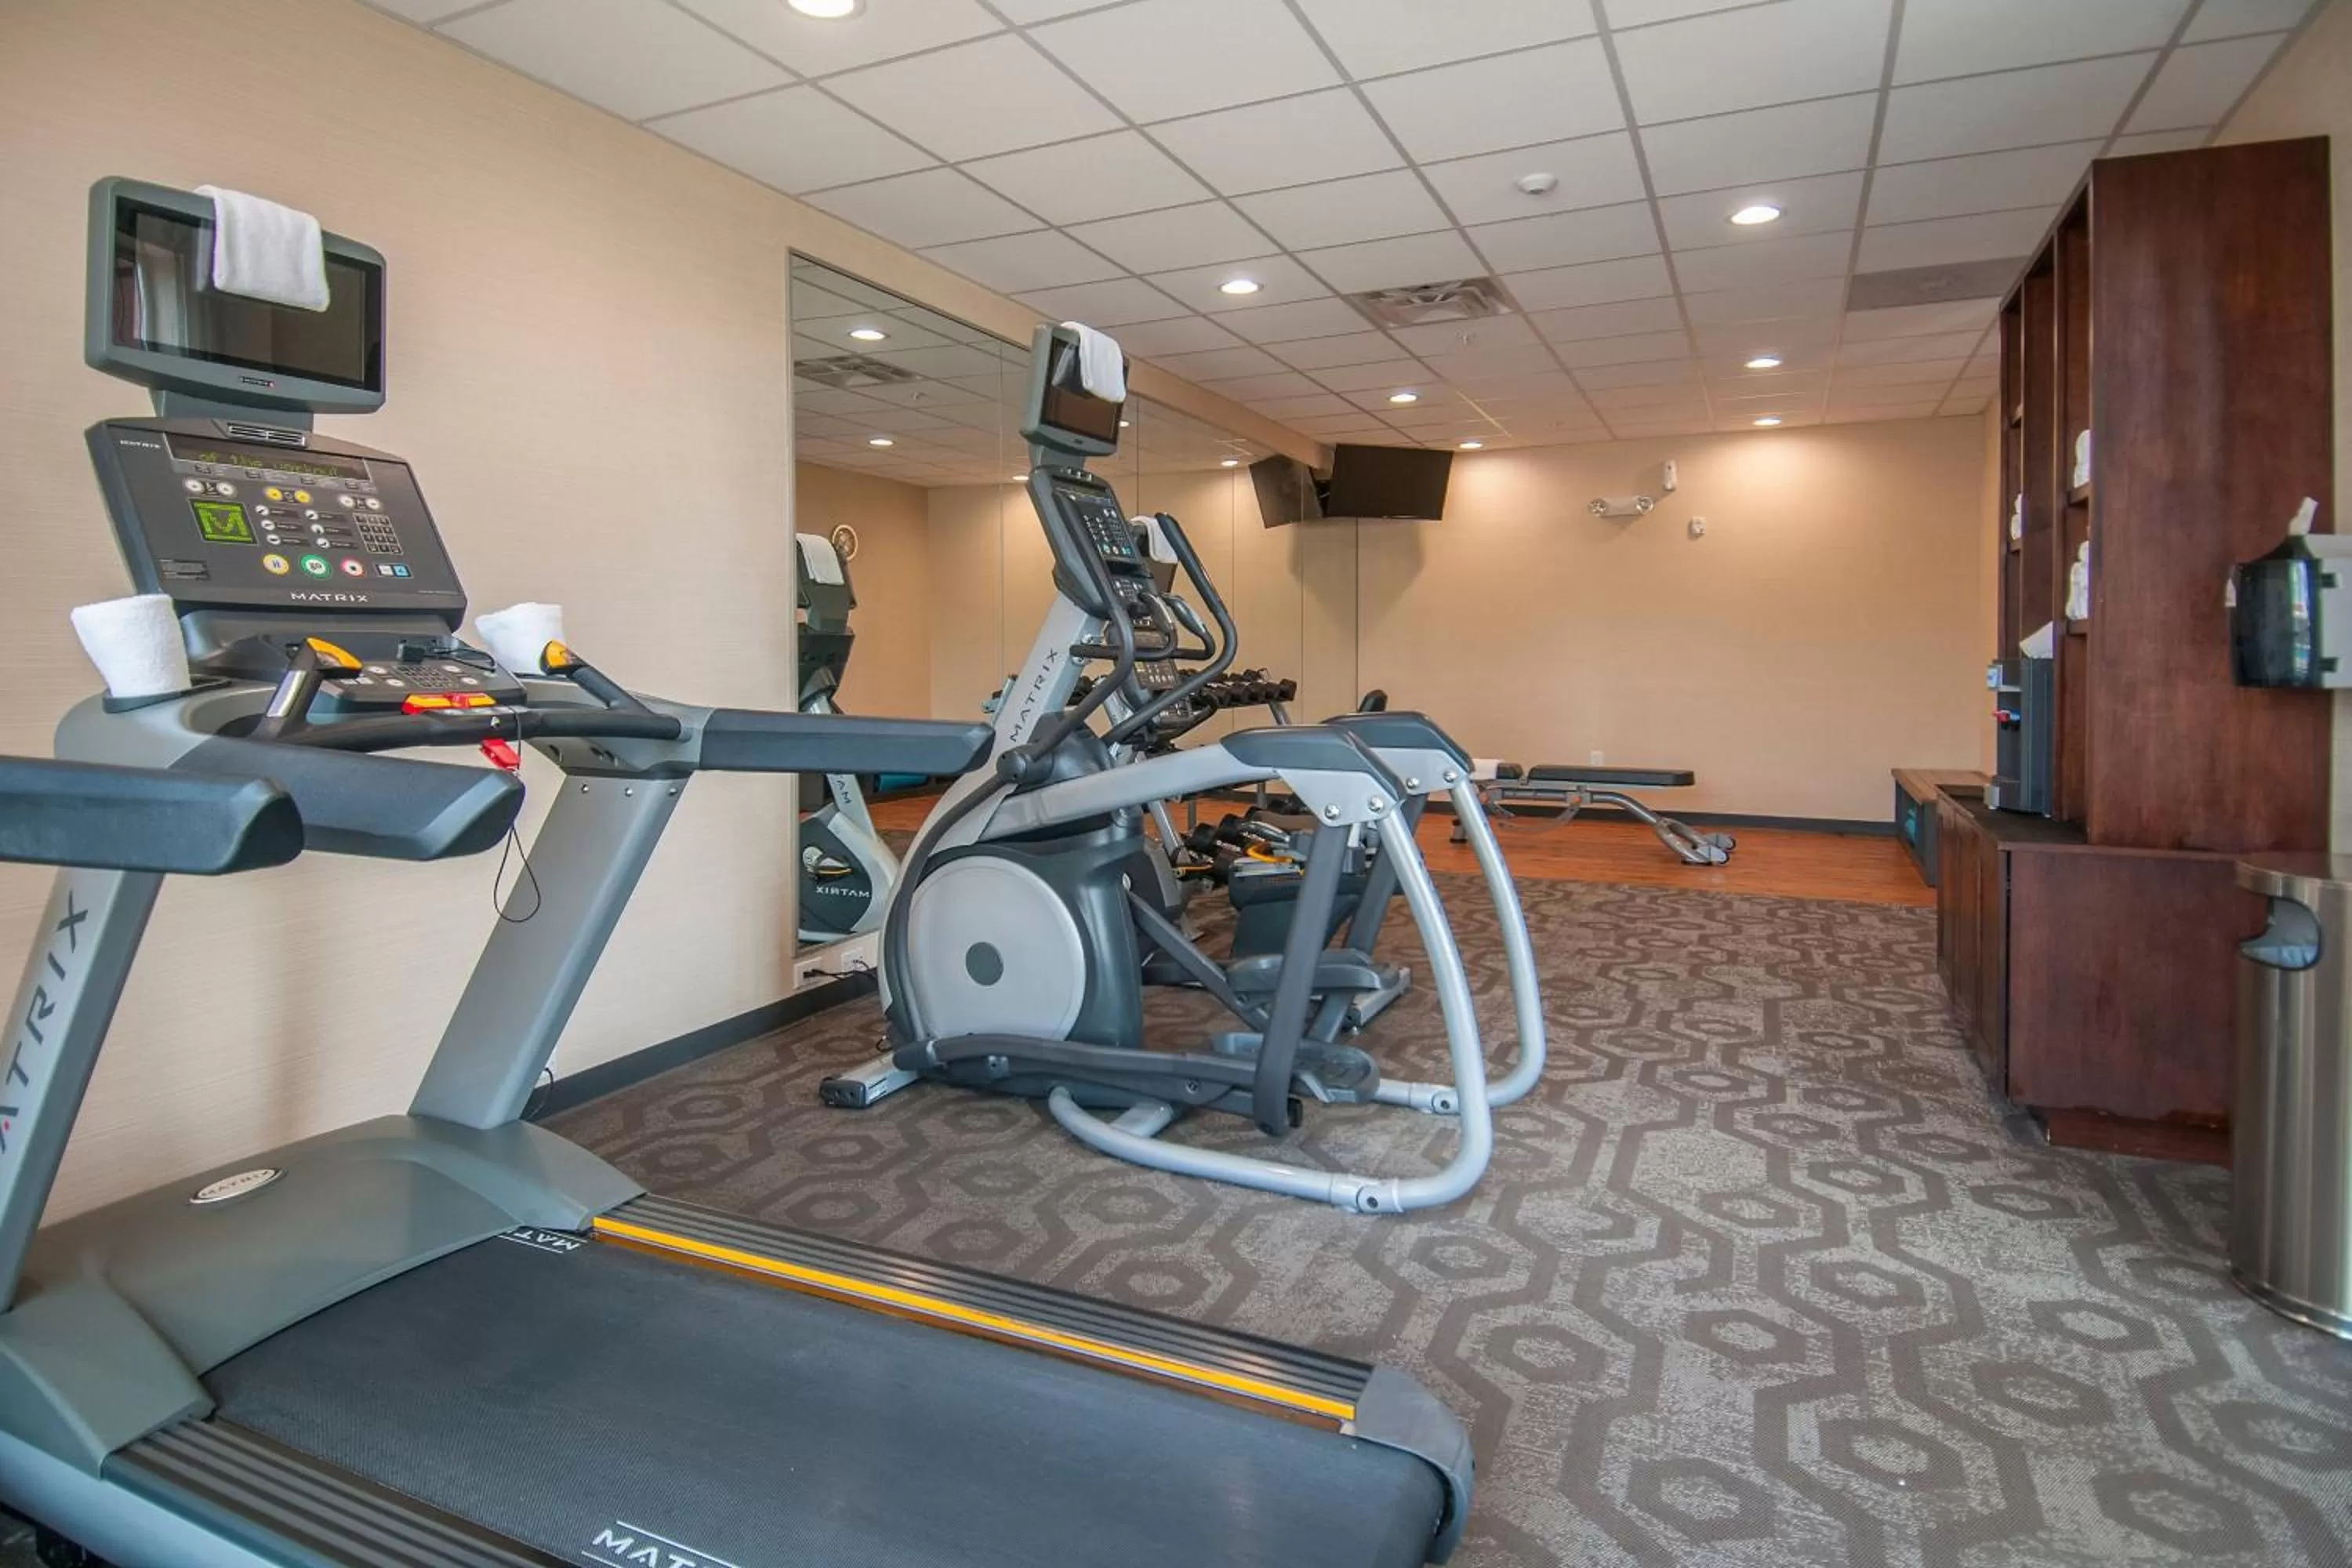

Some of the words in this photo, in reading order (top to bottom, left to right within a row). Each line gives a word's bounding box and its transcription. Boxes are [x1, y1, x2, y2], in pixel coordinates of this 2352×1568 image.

[290, 592, 368, 603] MATRIX
[1009, 647, 1058, 742] MATRIX
[0, 890, 89, 1154] ATRIX
[507, 1229, 581, 1250] MAT
[592, 1529, 706, 1568] MAT
